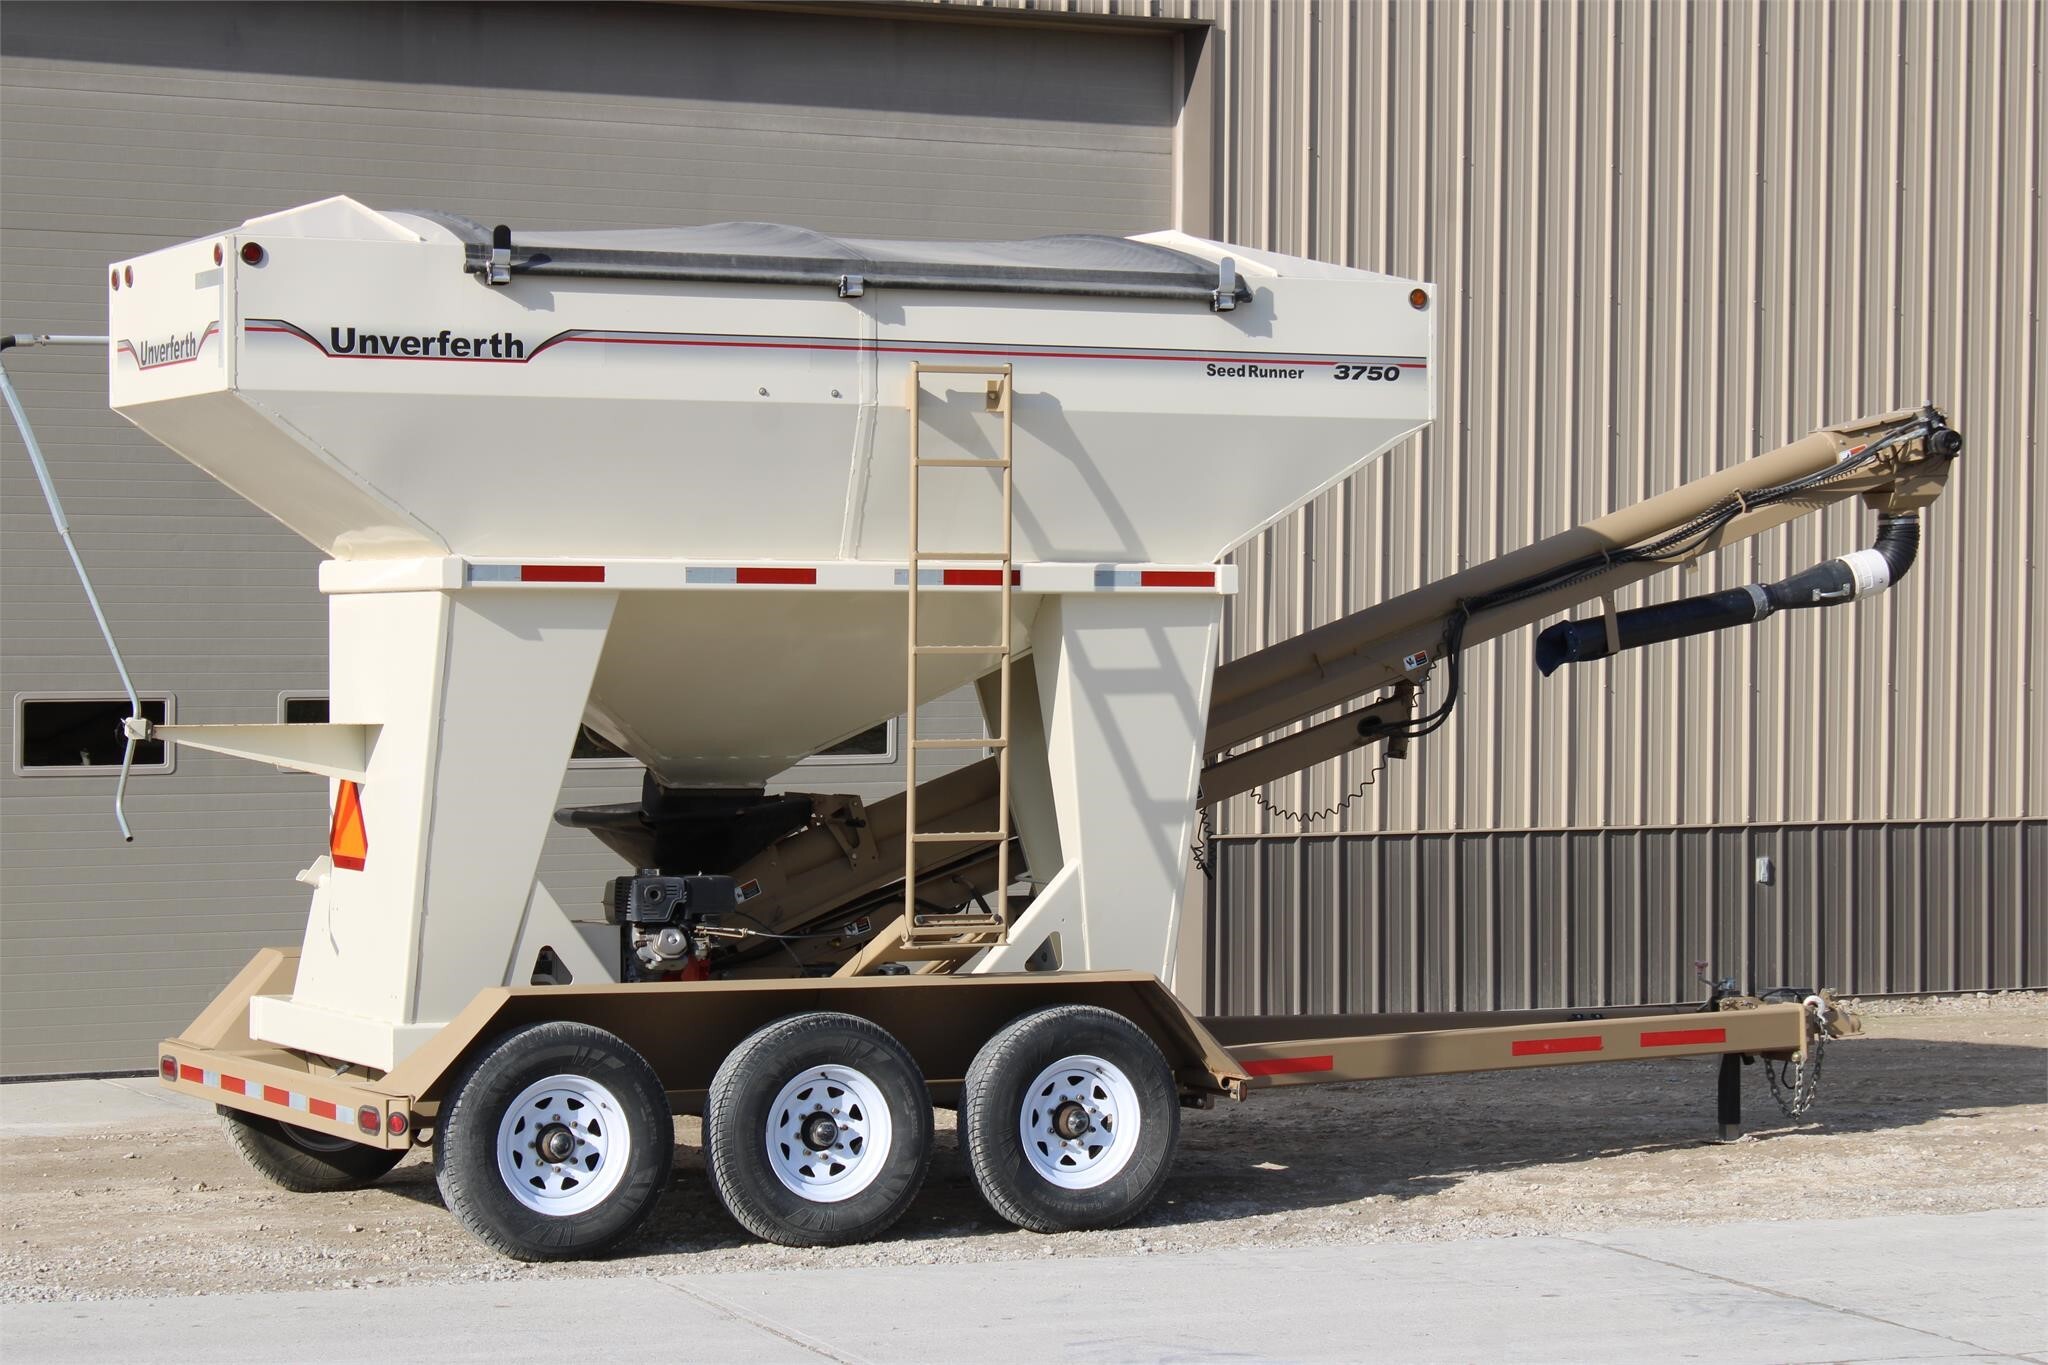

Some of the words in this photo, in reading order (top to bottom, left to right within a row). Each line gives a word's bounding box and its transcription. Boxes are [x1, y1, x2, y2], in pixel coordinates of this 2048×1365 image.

[140, 332, 196, 366] Unverferth
[331, 327, 524, 358] Unverferth
[1206, 363, 1246, 377] Seed
[1248, 365, 1304, 379] Runner
[1333, 364, 1400, 381] 3750
